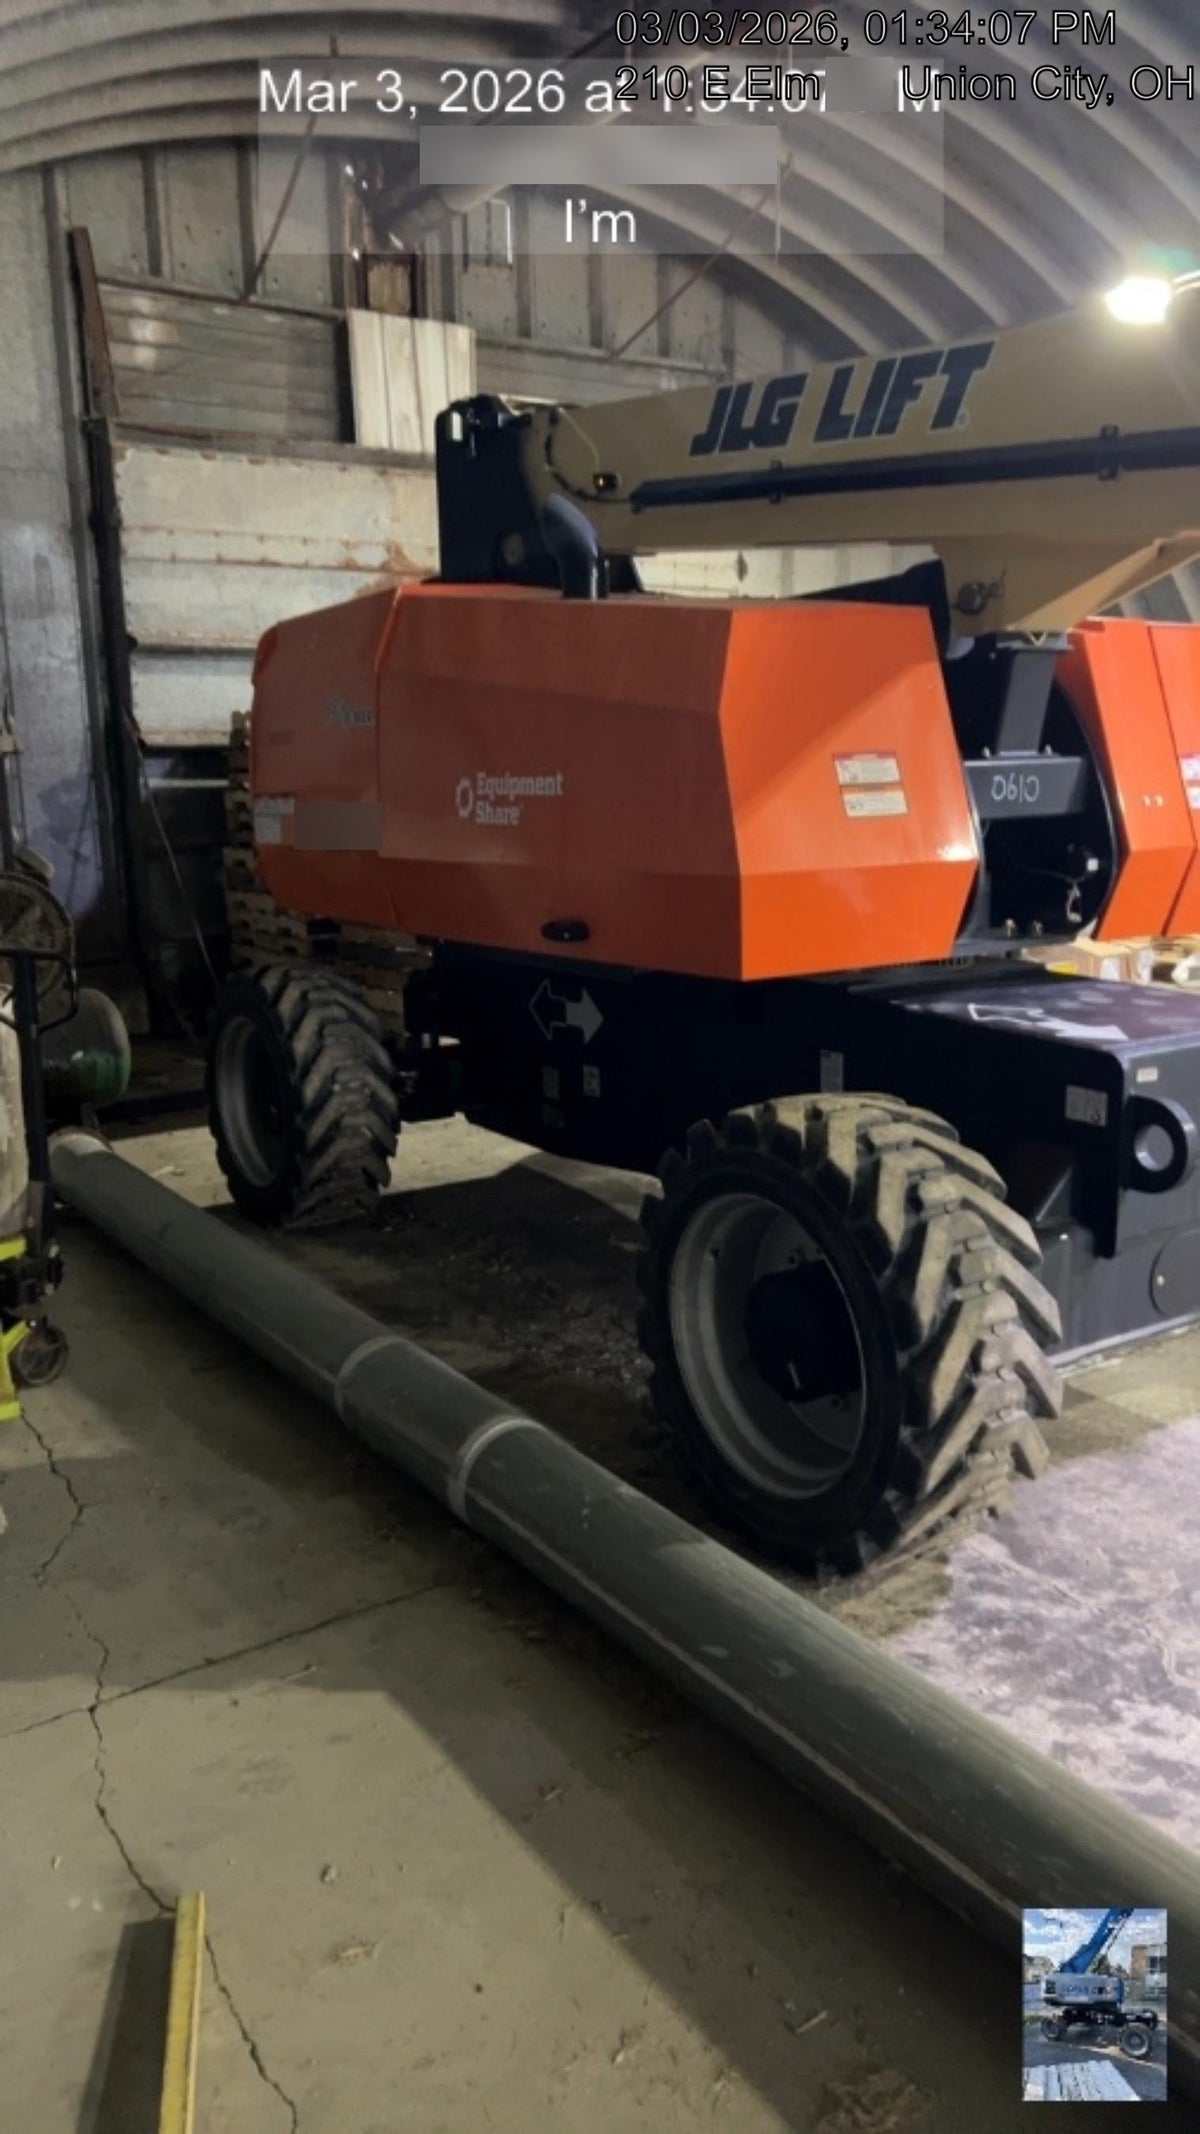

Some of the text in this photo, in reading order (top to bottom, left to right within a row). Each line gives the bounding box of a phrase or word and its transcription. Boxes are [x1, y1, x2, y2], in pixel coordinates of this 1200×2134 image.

[689, 341, 995, 456] JLG LIFT
[476, 771, 564, 801] Equipment
[476, 801, 521, 826] Share
